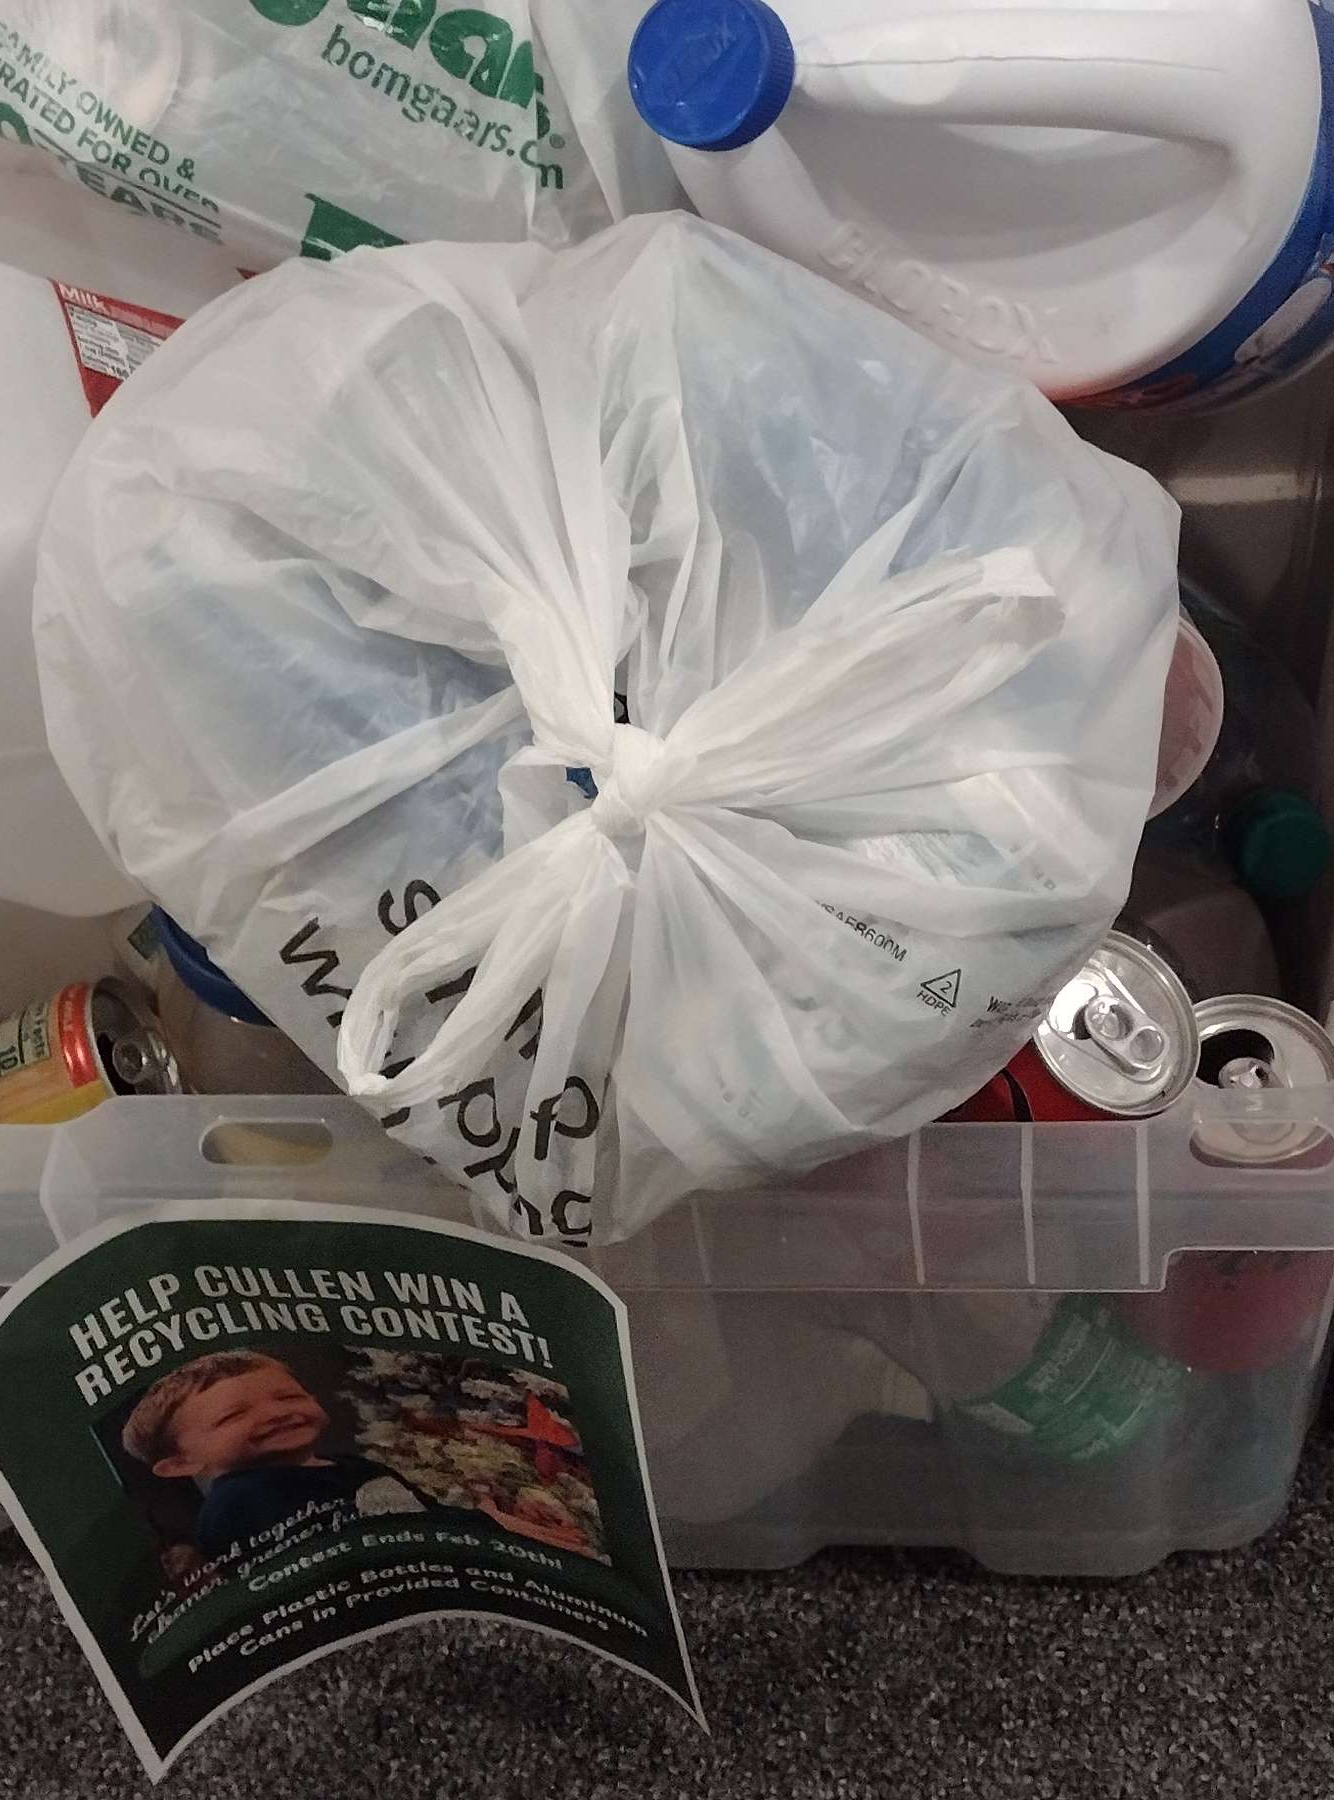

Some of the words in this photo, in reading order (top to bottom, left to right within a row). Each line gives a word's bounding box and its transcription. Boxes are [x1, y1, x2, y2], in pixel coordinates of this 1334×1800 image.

[76, 91, 170, 165] OWNED
[176, 157, 196, 182] &
[77, 128, 132, 174] FOR
[58, 283, 110, 315] Milk
[917, 990, 951, 1018] HDPE
[938, 980, 953, 995] 2
[68, 1273, 180, 1360] HELP
[194, 1265, 375, 1301] CULLEN
[384, 1271, 486, 1315] WIN
[500, 1291, 529, 1328] A
[74, 1301, 331, 1406] RECYCLING
[340, 1305, 553, 1369] CONTEST!
[183, 1541, 242, 1587] work
[250, 1498, 347, 1548] together
[248, 1541, 352, 1592] Contest
[362, 1530, 425, 1547] Ends
[435, 1530, 480, 1547] Feb
[188, 1624, 254, 1673] Place
[263, 1580, 351, 1624] Plastic
[361, 1560, 454, 1584] Bottles
[465, 1566, 515, 1583] and
[524, 1579, 648, 1638] Aluminum
[240, 1620, 304, 1656] Cans
[346, 1577, 461, 1608] Provided
[470, 1579, 609, 1631] Containers
